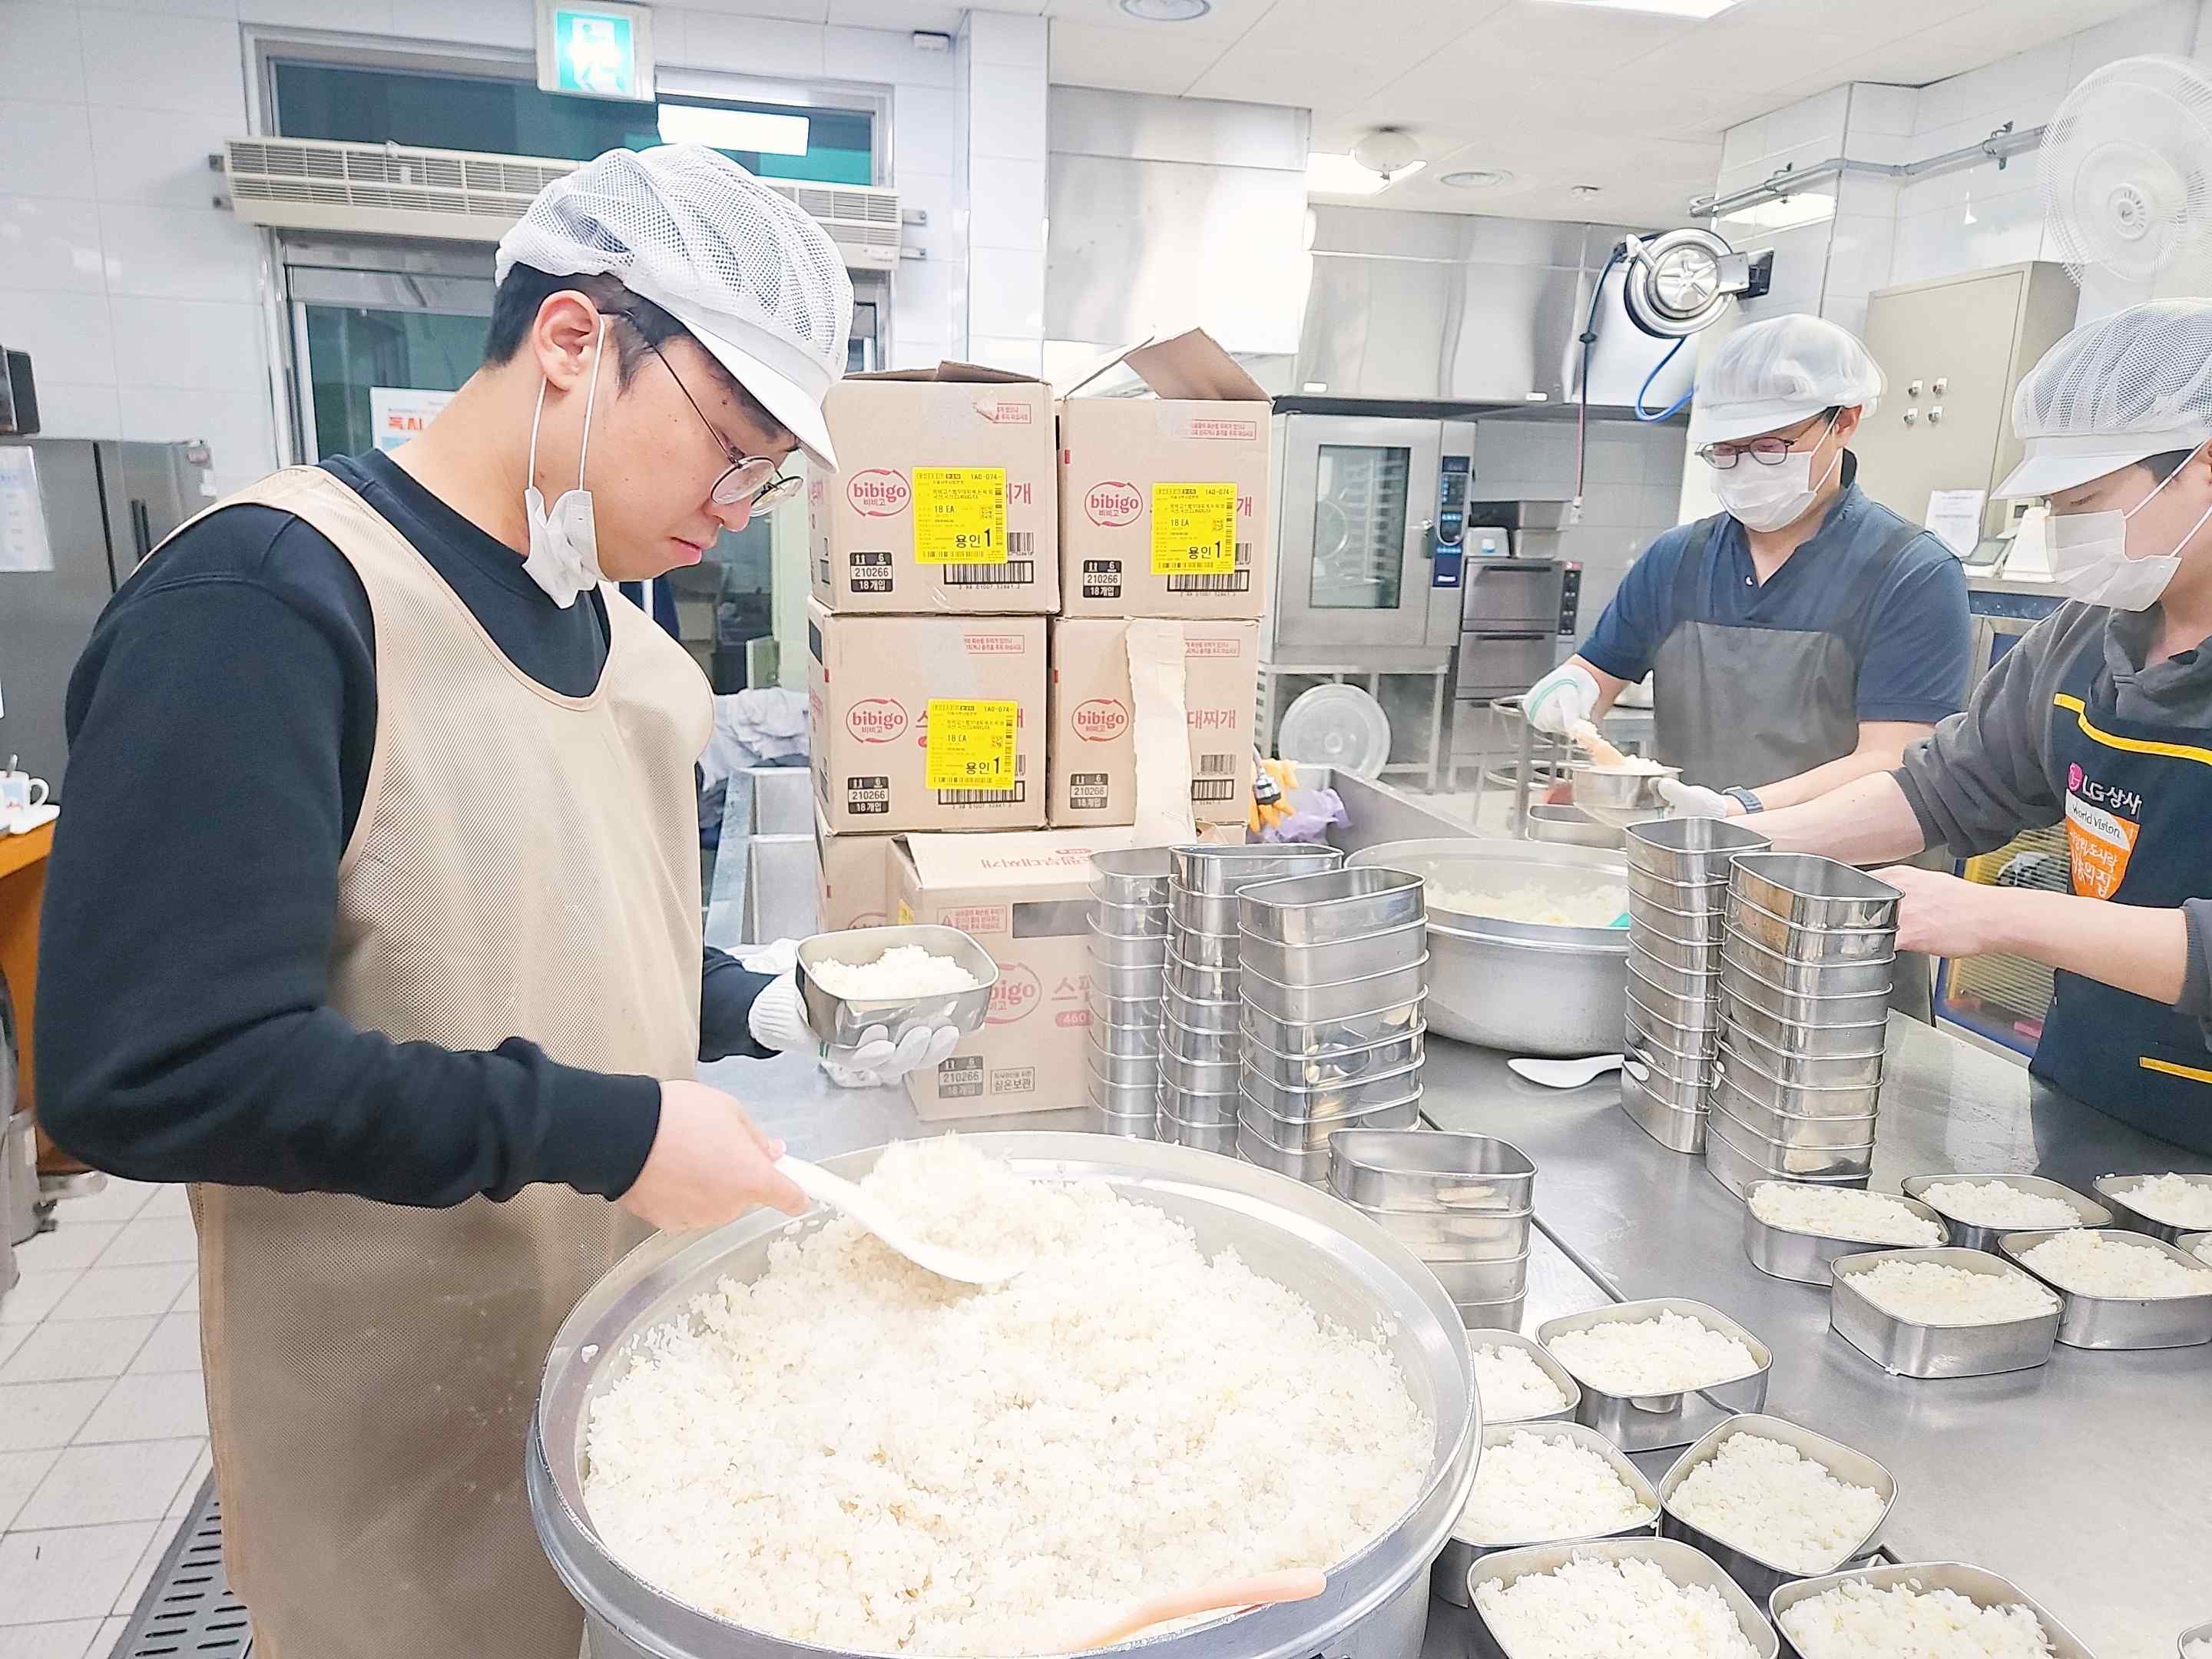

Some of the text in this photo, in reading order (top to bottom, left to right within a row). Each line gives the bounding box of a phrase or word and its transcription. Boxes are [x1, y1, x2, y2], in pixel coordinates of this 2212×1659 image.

[853, 482, 906, 503] bibigo
[1091, 494, 1139, 514] bibigo
[955, 528, 991, 548] 용인 1
[1188, 540, 1221, 559] 용인 1
[854, 567, 889, 577] 210266
[1087, 575, 1118, 584] 210266
[859, 580, 886, 591] 18개입
[853, 710, 903, 730] bibigo
[1078, 710, 1124, 729] bibigo
[965, 756, 1000, 775] 용인 1
[852, 790, 886, 800] 210266
[1074, 786, 1104, 796] 210266
[2082, 774, 2142, 815] LG상사
[2072, 803, 2121, 839] World Vision
[943, 1071, 979, 1083] 210266
